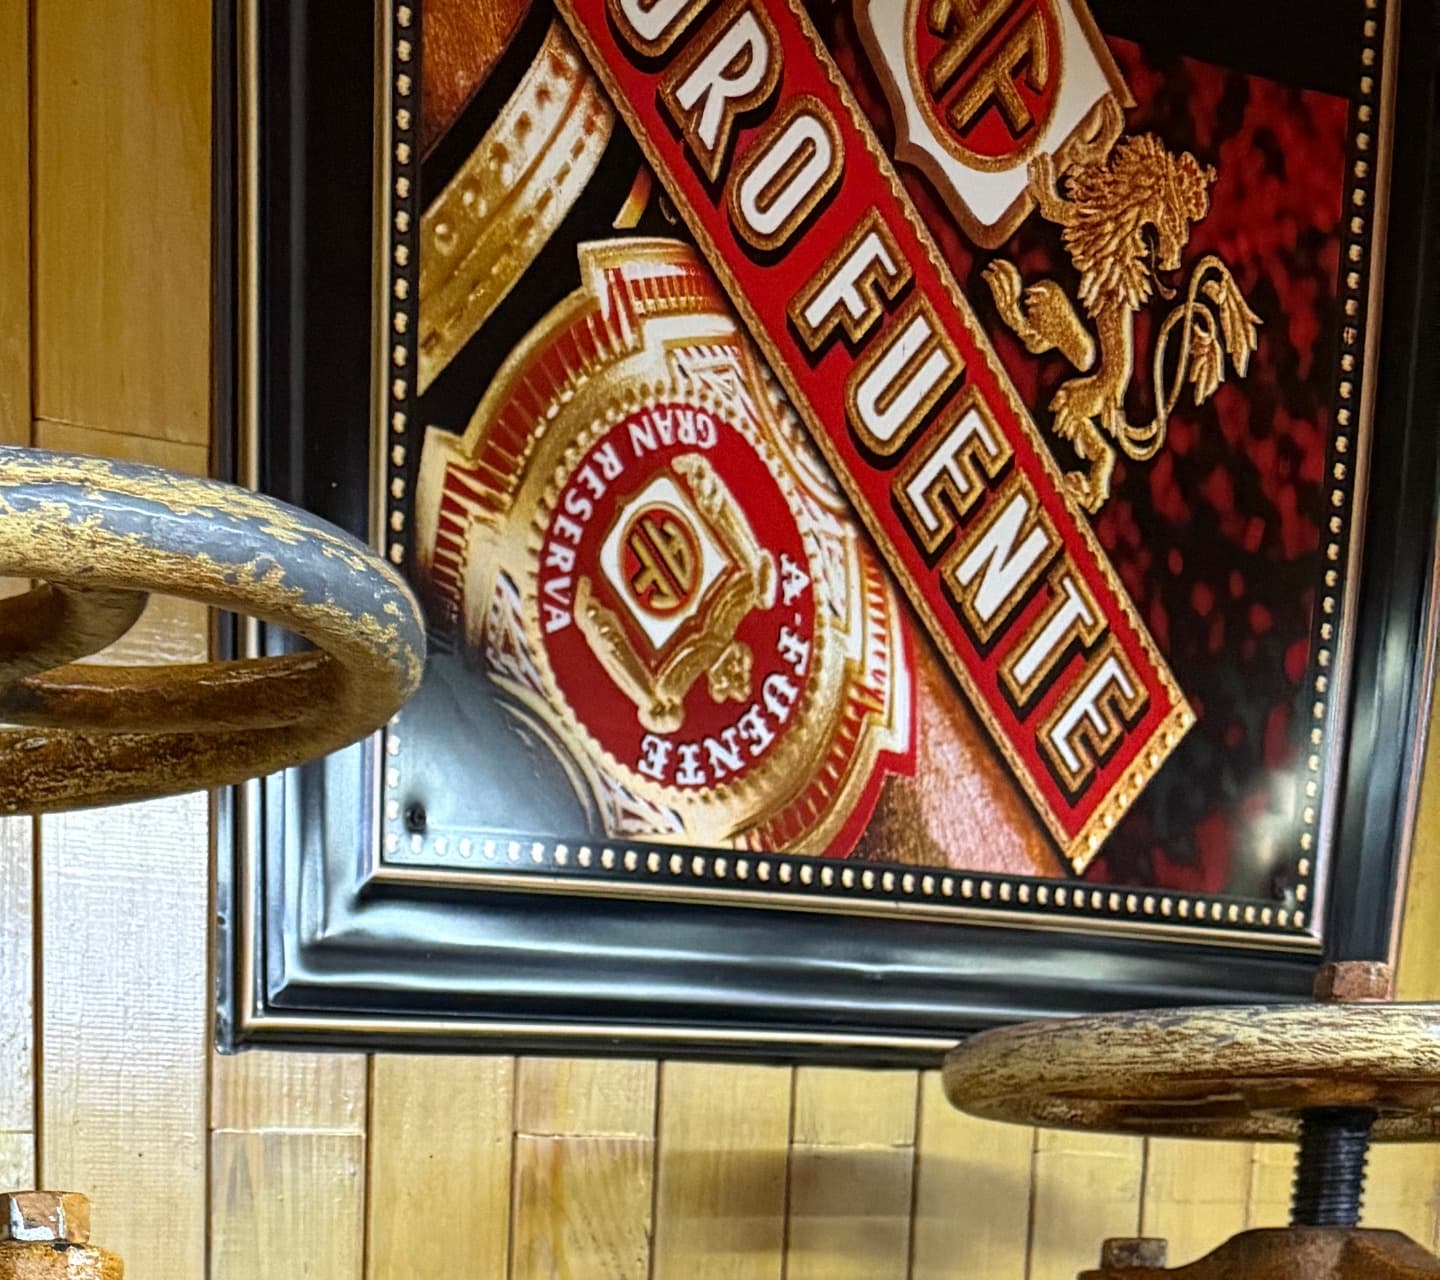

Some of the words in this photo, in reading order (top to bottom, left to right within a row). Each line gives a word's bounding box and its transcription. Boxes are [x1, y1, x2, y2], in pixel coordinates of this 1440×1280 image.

[628, 407, 718, 456] GRAN
[787, 208, 1149, 793] FUENTE
[543, 441, 624, 634] RESERVA
